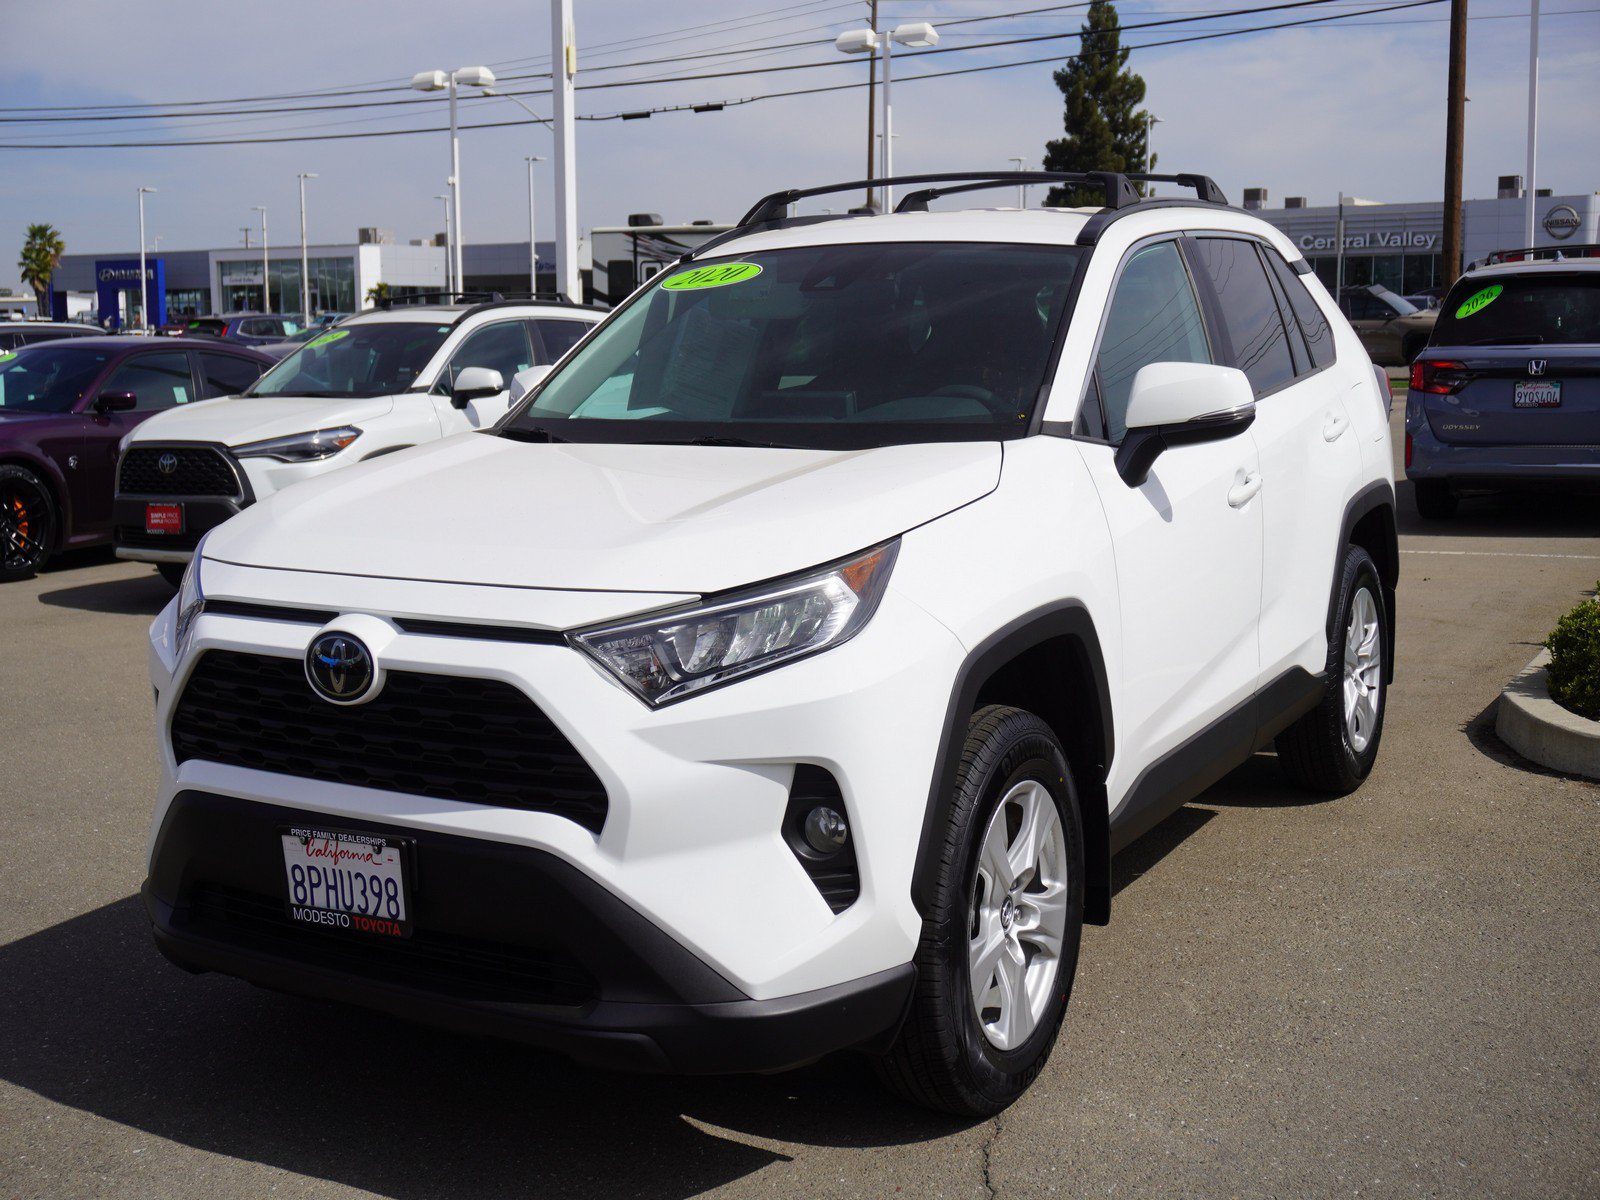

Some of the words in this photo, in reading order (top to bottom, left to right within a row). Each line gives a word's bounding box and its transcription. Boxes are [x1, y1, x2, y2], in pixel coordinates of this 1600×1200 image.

[1546, 218, 1578, 226] NISSAN
[1377, 232, 1437, 249] Valley
[670, 266, 749, 287] 2020
[1464, 289, 1494, 315] 2026
[291, 828, 311, 837] PRICE
[313, 831, 337, 841] FAMILY
[338, 834, 387, 846] DEALERSHIPS
[306, 838, 382, 865] California
[291, 864, 400, 921] 8PHU398
[292, 907, 350, 928] MODESTO
[352, 916, 401, 936] TOYOTA
